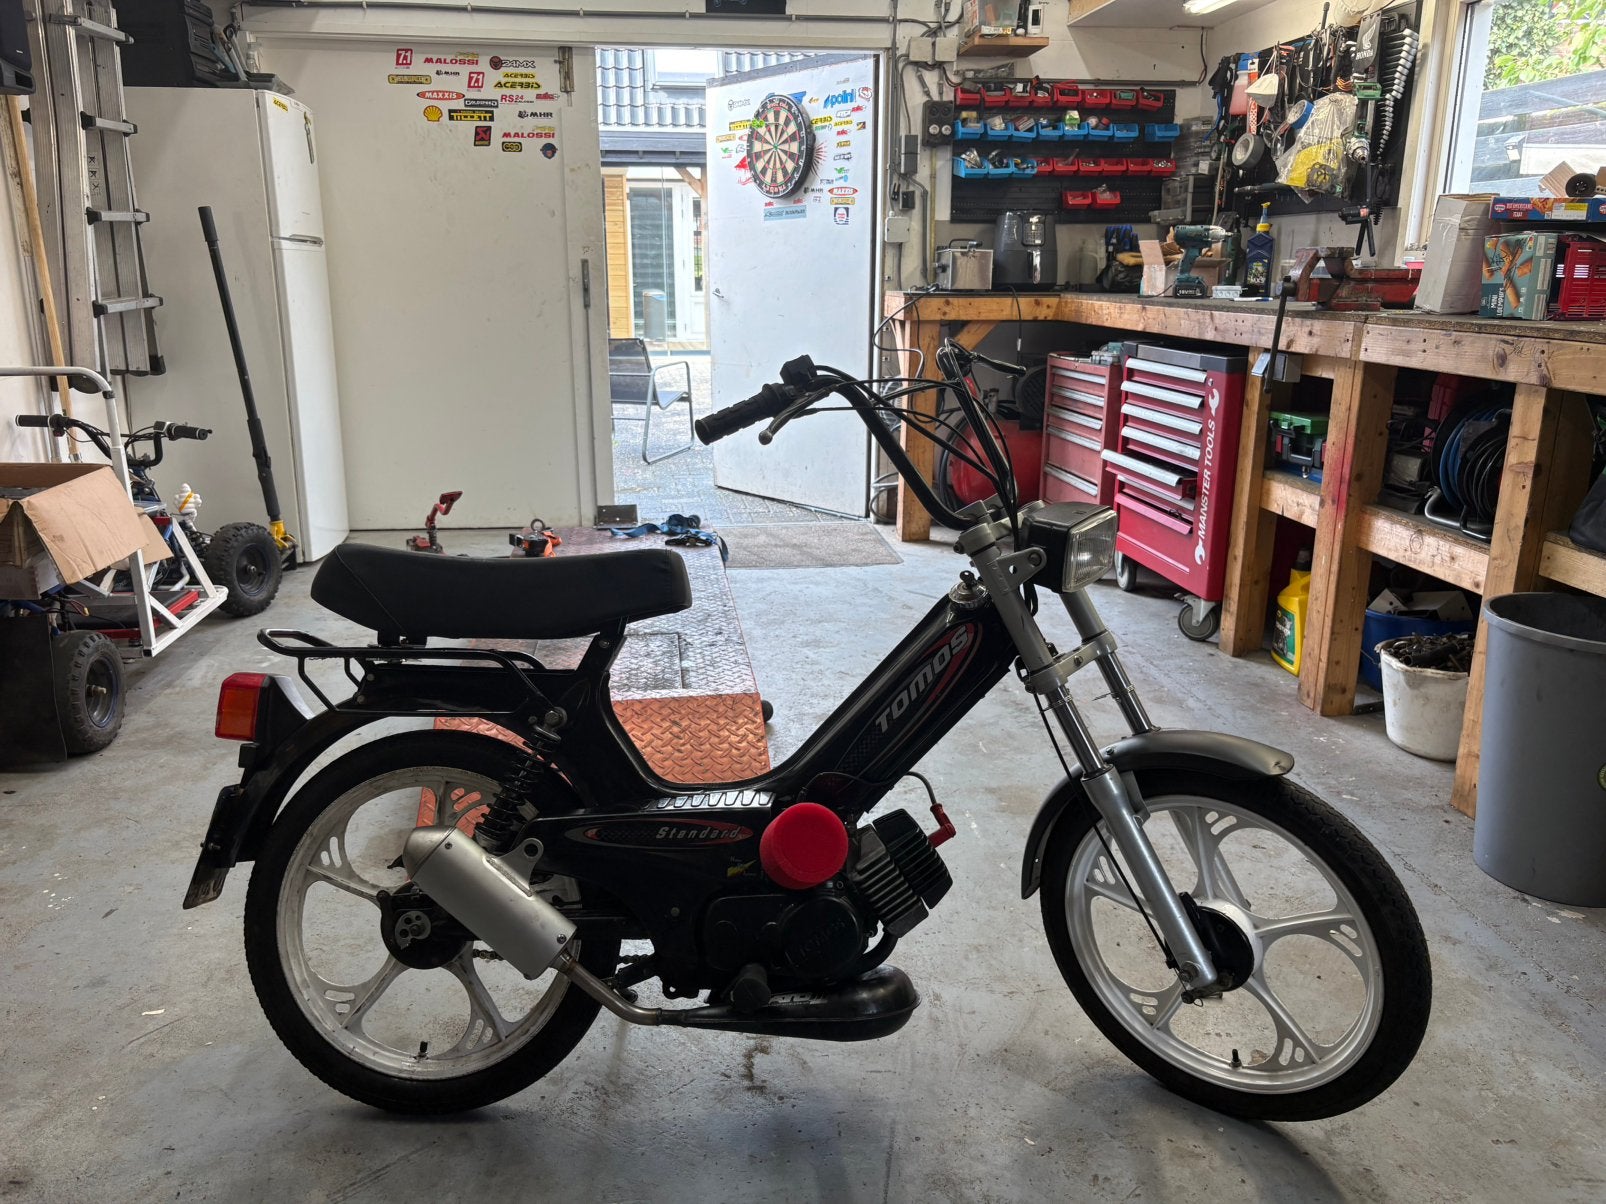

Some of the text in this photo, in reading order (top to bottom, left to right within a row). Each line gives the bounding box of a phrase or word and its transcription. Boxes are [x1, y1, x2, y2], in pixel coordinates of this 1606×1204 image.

[423, 57, 479, 66] MALOSSI
[1198, 418, 1216, 540] MANSTER TOOLS
[875, 625, 968, 733] TOMOS
[655, 826, 742, 840] Standard
